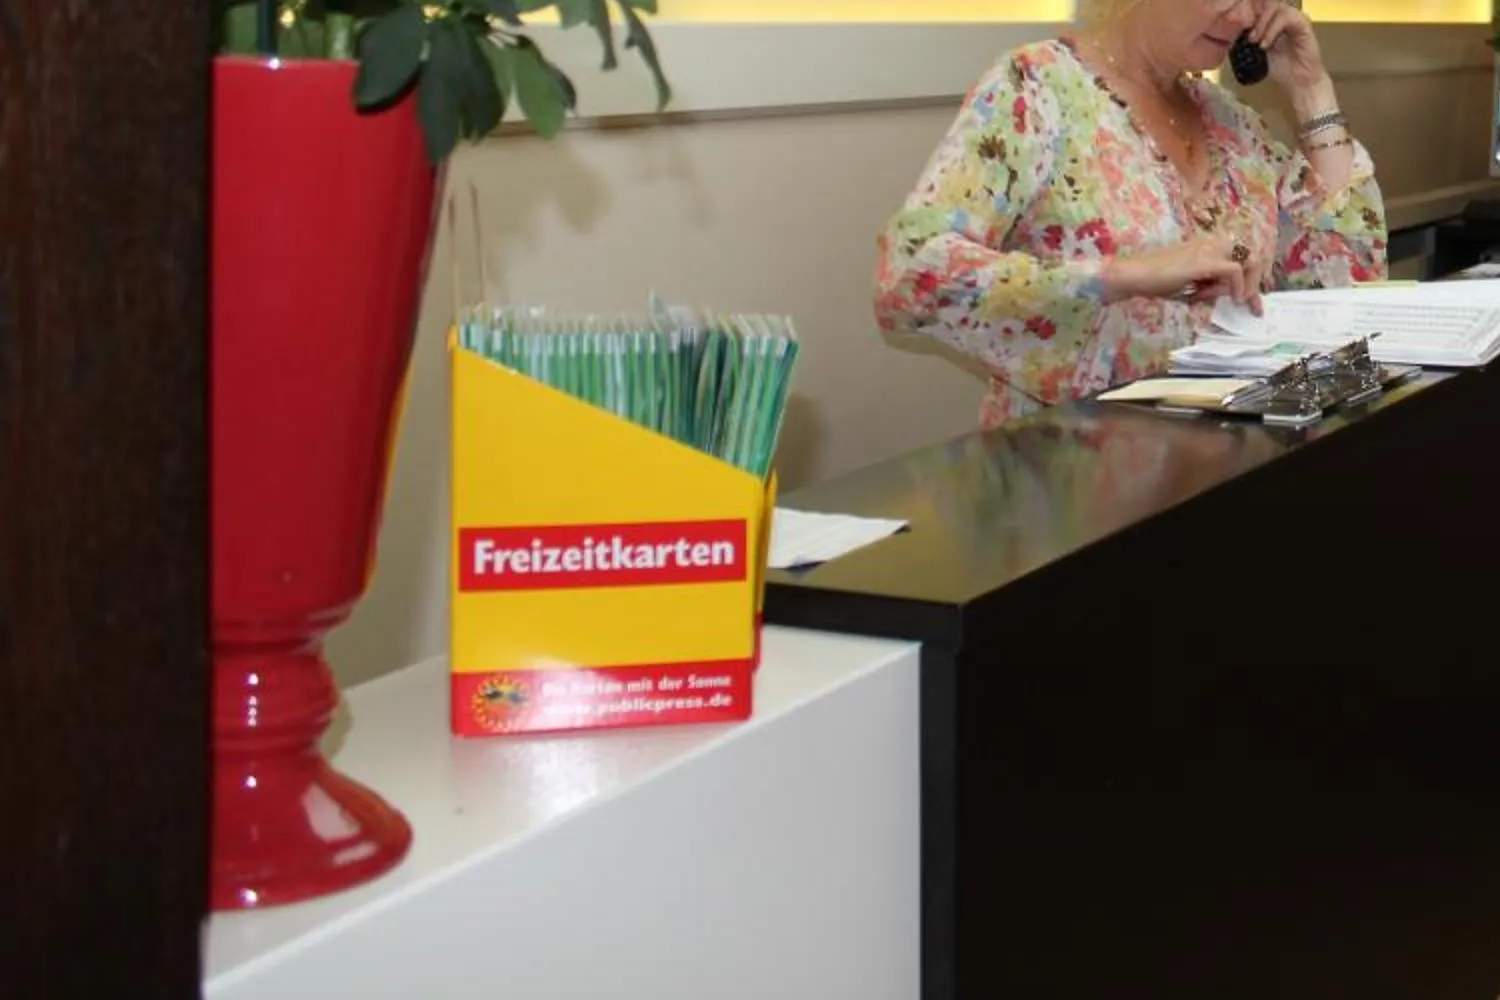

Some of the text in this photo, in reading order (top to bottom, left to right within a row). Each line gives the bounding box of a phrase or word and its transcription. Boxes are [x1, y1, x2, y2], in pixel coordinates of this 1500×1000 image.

[474, 535, 735, 575] Freizeitkarten
[627, 677, 653, 693] mit
[658, 675, 683, 691] der
[687, 674, 732, 689] Sonne
